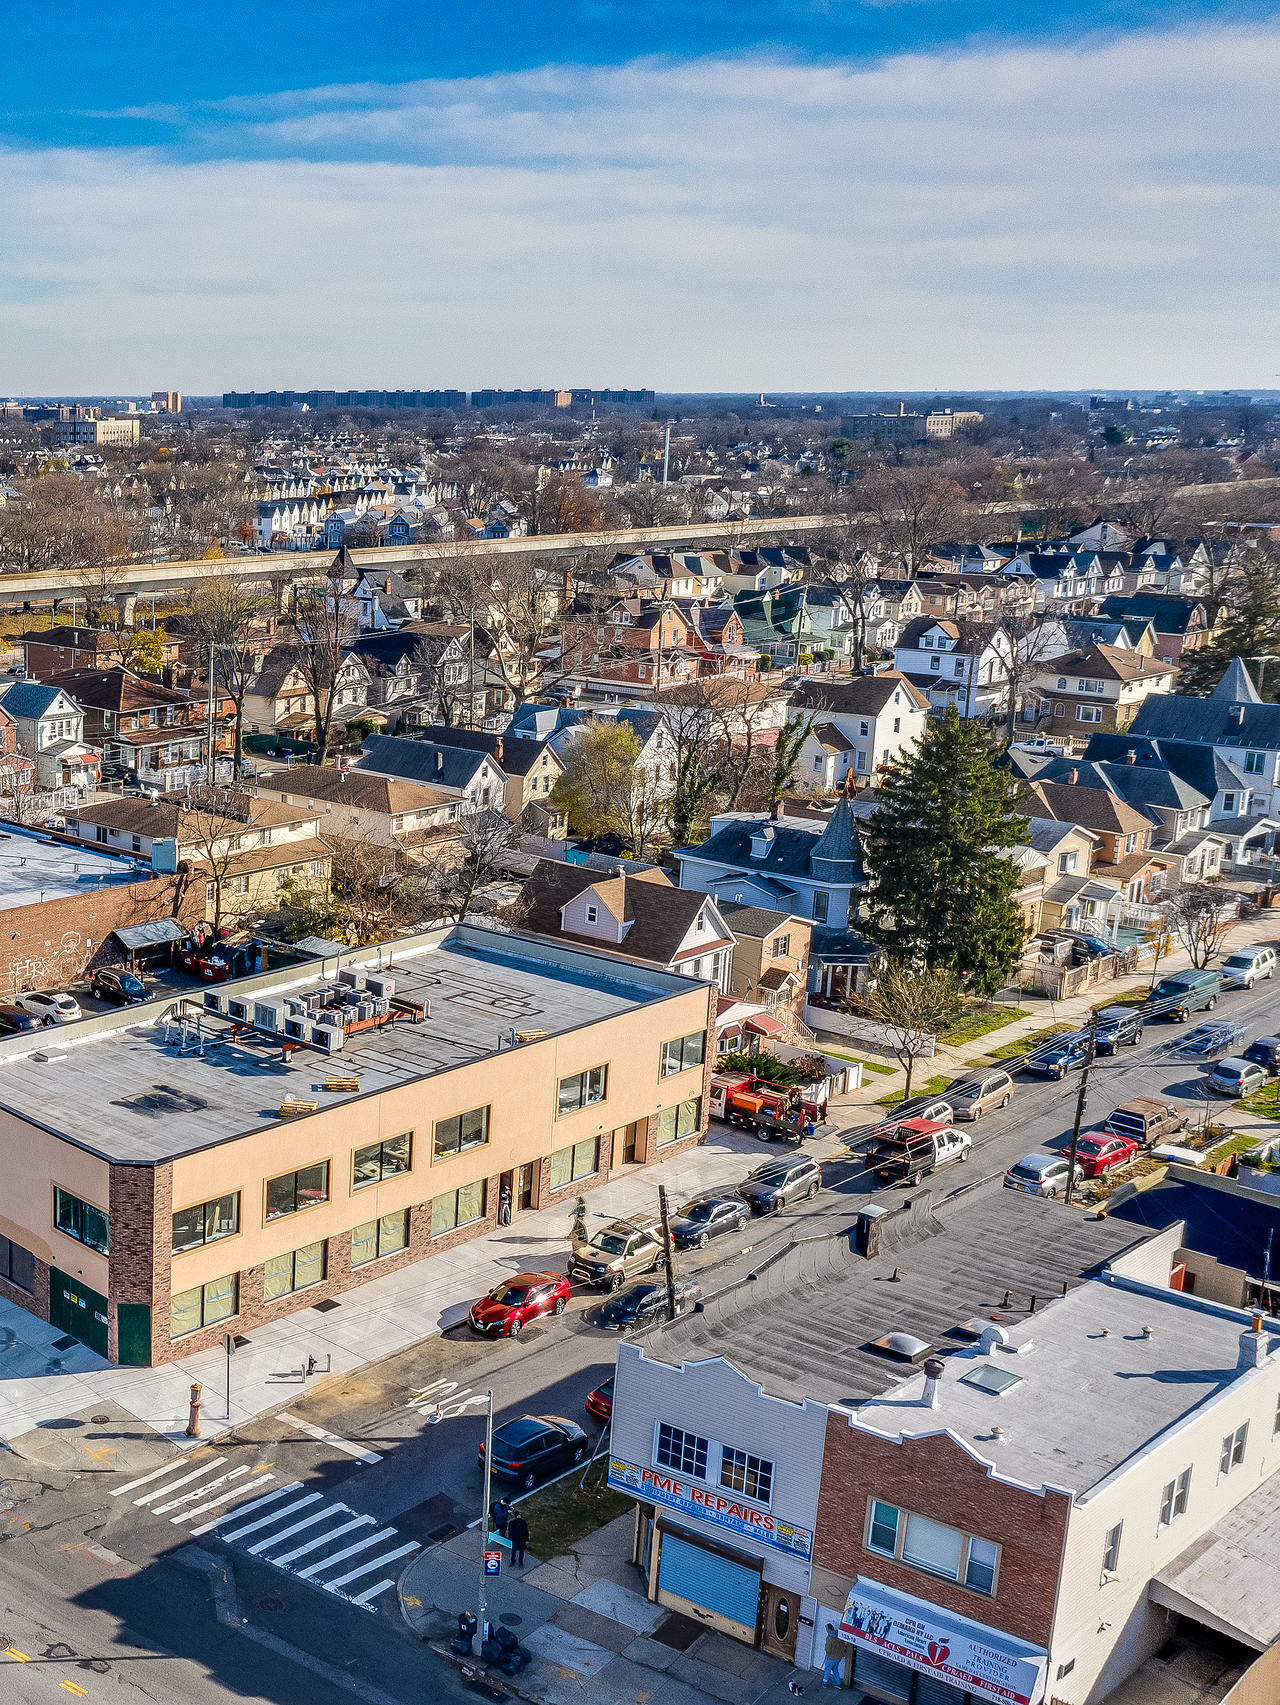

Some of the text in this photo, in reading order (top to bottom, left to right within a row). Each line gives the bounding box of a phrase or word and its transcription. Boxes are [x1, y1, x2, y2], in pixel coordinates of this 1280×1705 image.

[641, 1469, 683, 1497] PME
[691, 1487, 774, 1531] REPAIRS
[892, 1620, 915, 1634] DEMAND
[916, 1629, 924, 1637] NY
[904, 1618, 916, 1627] CPR
[864, 1633, 879, 1643] BLS
[883, 1641, 901, 1652] ACLS
[906, 1649, 924, 1661] PALS
[969, 1644, 1018, 1668] AUTHORIZED
[966, 1660, 1010, 1681] PROVIDER
[972, 1654, 1008, 1674] TRAINING
[933, 1670, 944, 1679] AID
[945, 1674, 977, 1693] TRAINING
[941, 1665, 1016, 1699] CPR/AED FIRST AID
